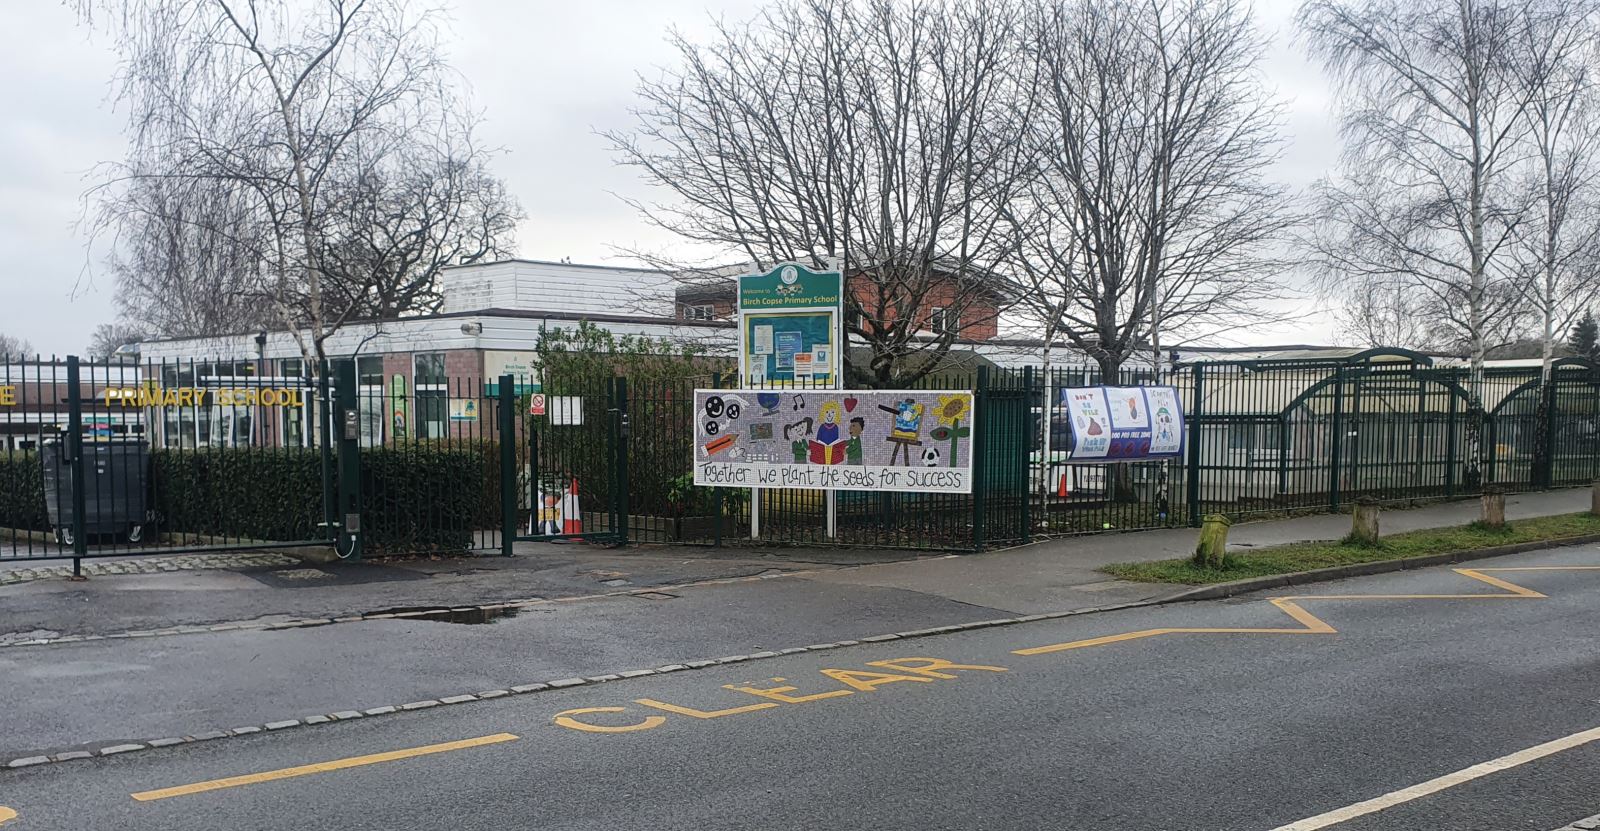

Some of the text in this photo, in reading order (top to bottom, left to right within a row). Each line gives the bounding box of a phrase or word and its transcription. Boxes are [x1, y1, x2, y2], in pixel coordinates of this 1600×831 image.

[762, 298, 782, 306] Copse
[784, 296, 812, 305] Primary
[813, 295, 838, 303] School
[104, 387, 207, 407] PRIMARY
[217, 387, 304, 407] SCHOOL
[698, 461, 962, 488] Together we plant the seeds for success
[552, 656, 1009, 733] CLEAR
